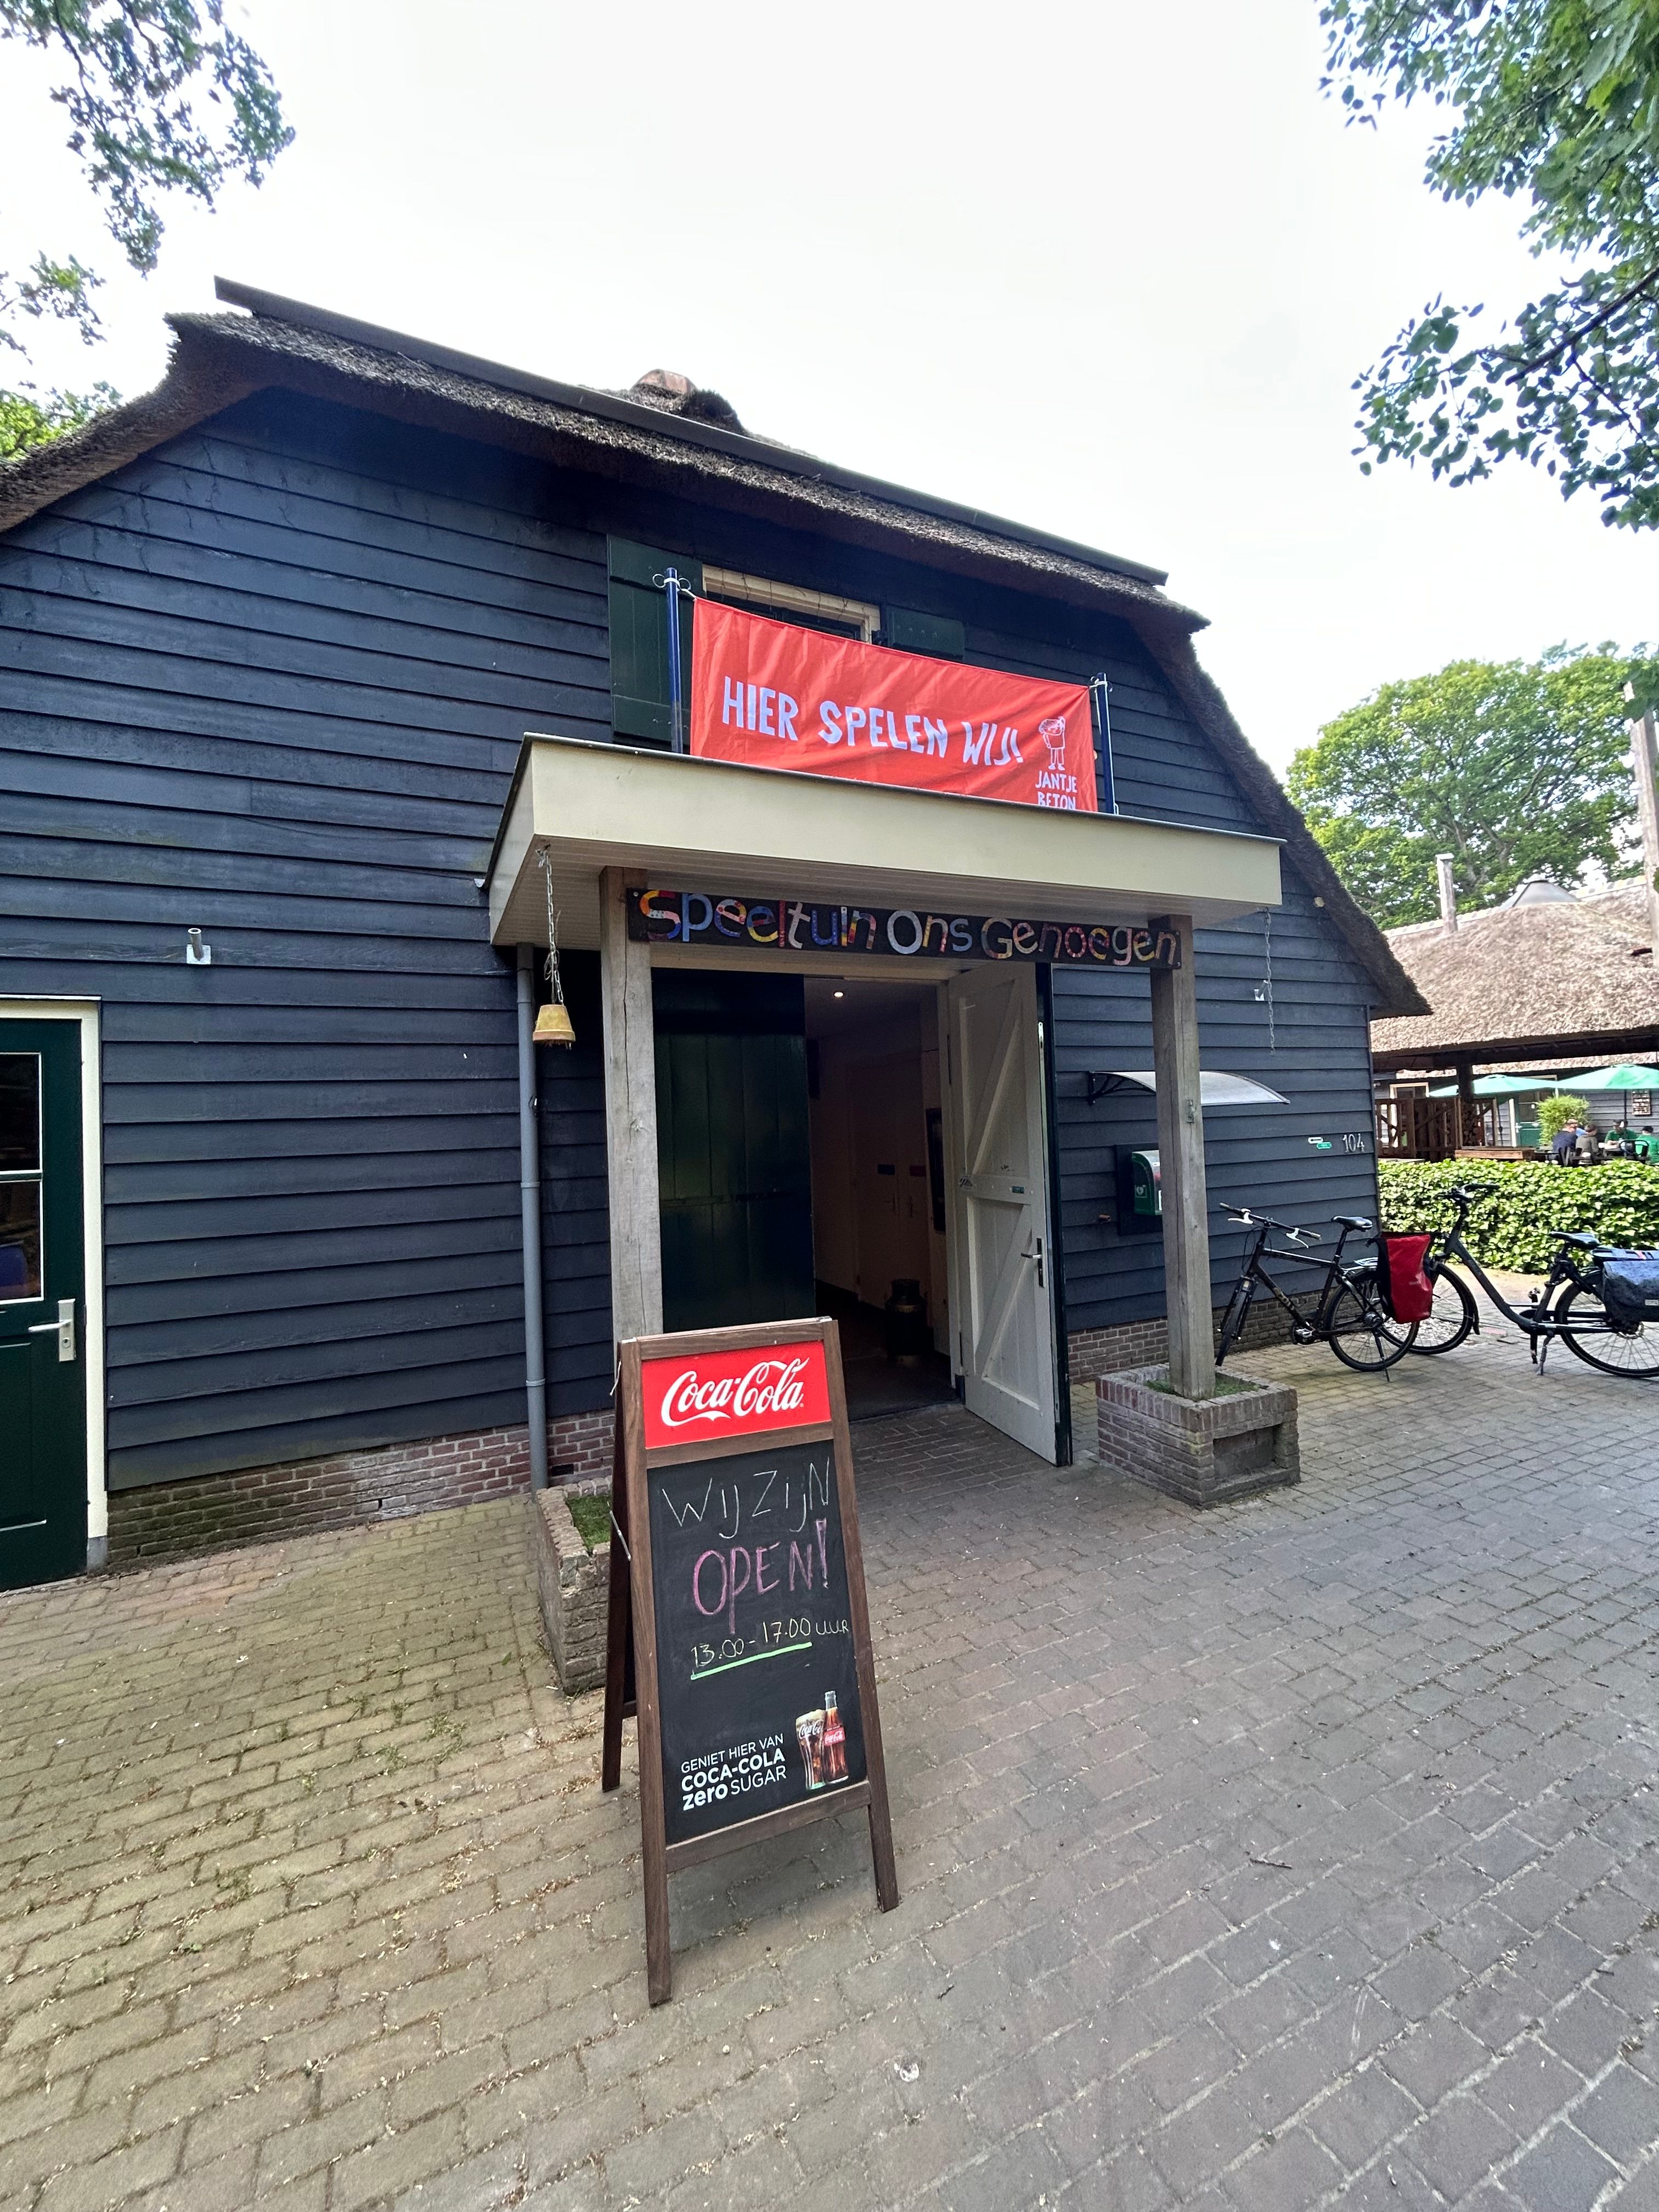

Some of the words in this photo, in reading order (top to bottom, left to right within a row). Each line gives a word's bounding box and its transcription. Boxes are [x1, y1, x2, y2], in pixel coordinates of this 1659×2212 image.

[721, 675, 798, 741] HIER
[818, 700, 948, 759] SPELEN
[961, 721, 1024, 766] WIJ!
[1035, 770, 1078, 793] JANTJE
[1037, 791, 1076, 810] BETON
[639, 889, 877, 950] Speeltuin
[886, 910, 973, 955] Ons
[981, 916, 1177, 966] Genoegen
[1342, 1133, 1365, 1153] 104
[661, 1357, 810, 1427] Coca-Cola
[692, 1517, 828, 1635] OPEN!
[763, 1617, 811, 1643] 17.00
[681, 1750, 726, 1774] GENIET
[729, 1741, 756, 1760] HIER
[759, 1733, 784, 1751] VAN
[681, 1748, 786, 1792] COCA-COLA
[682, 1783, 729, 1812] zero
[730, 1765, 787, 1796] SUGAR
